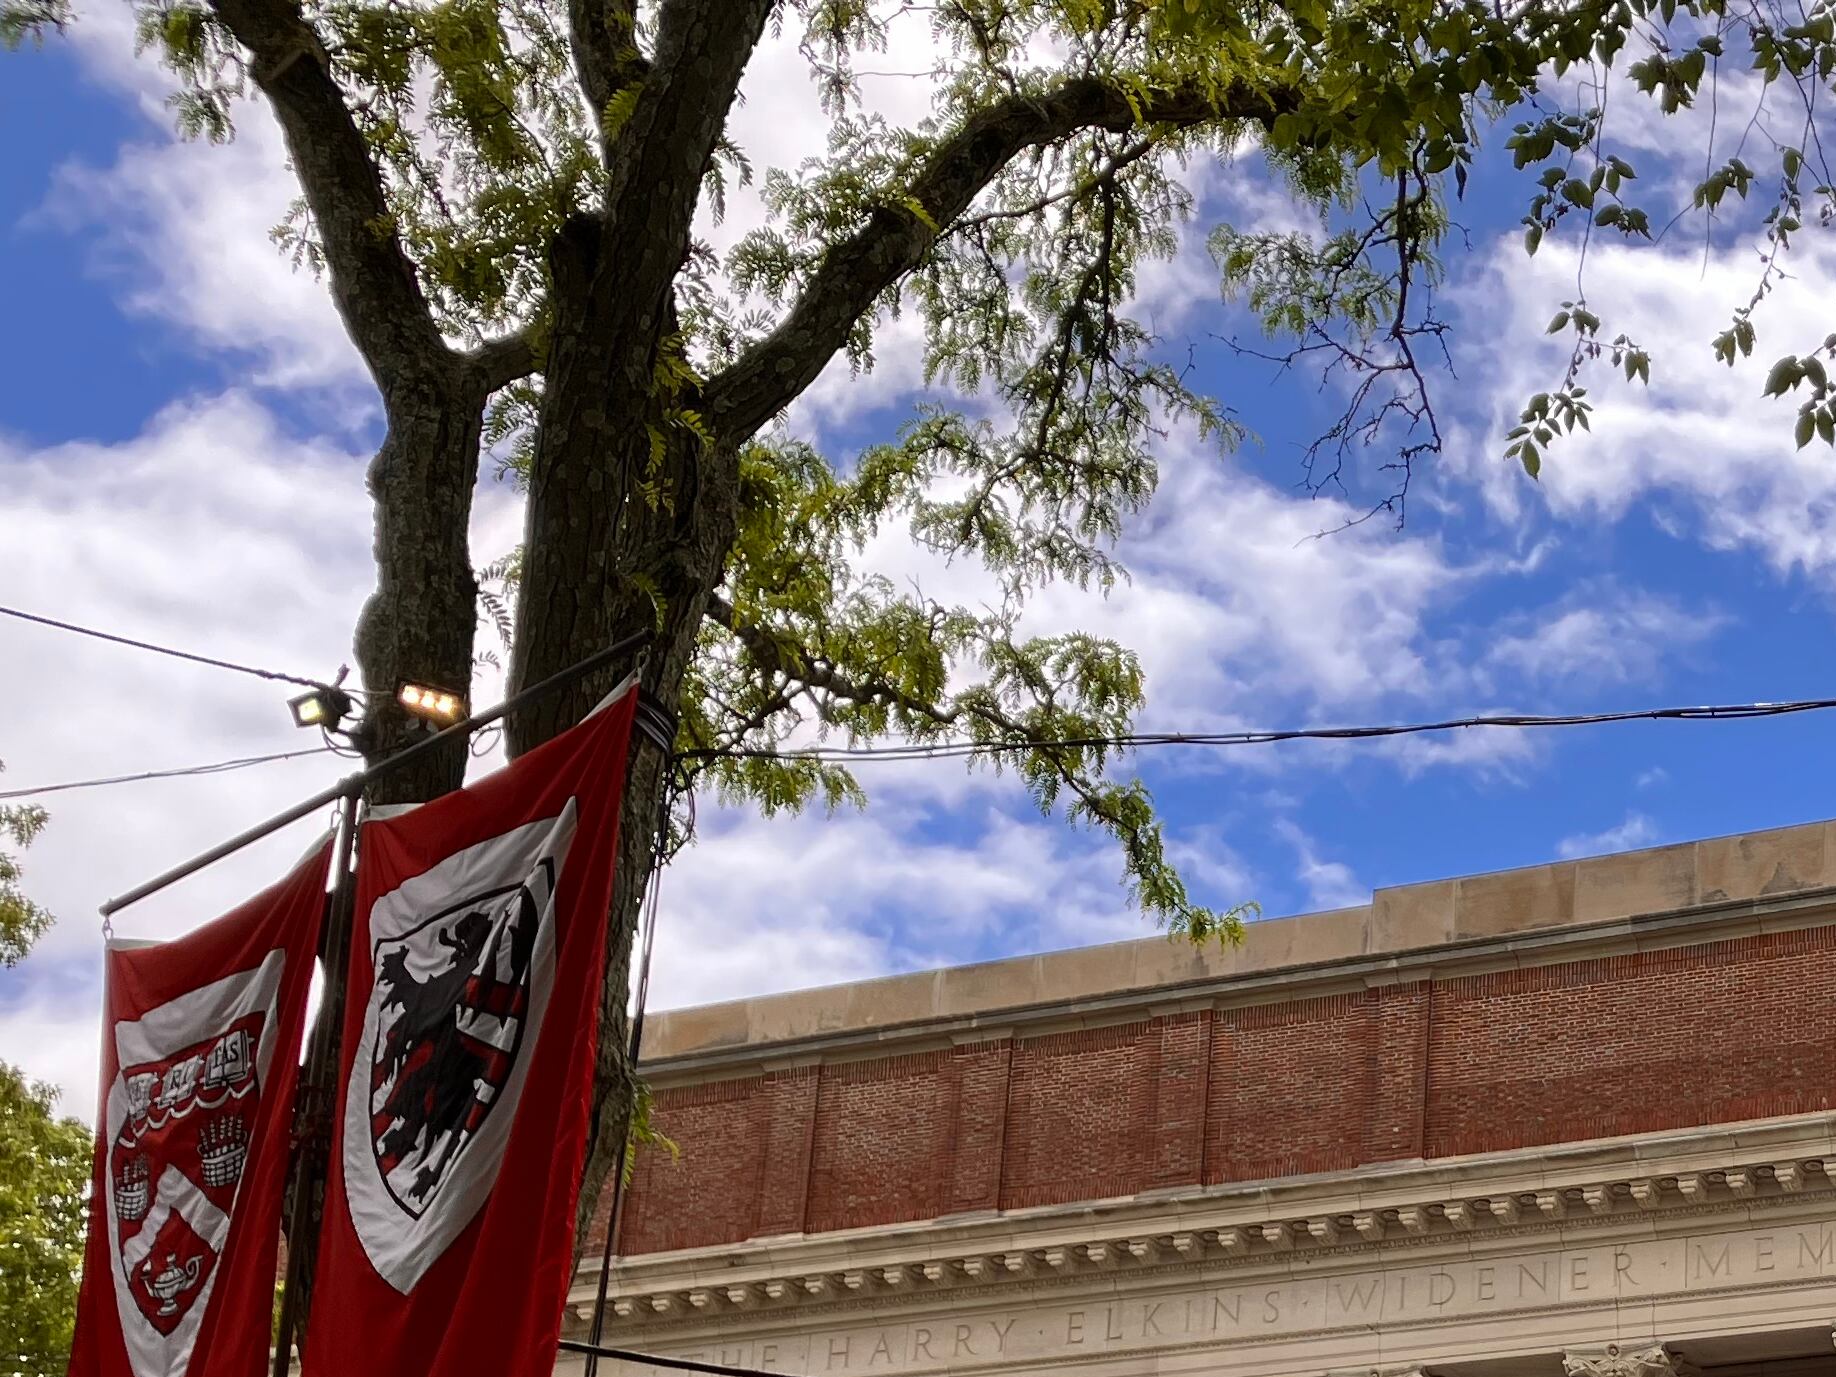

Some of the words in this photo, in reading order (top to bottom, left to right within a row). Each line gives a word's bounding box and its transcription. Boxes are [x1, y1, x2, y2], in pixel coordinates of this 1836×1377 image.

[825, 1317, 1018, 1369] HARRY
[1066, 1288, 1282, 1346] ELKINS
[1333, 1250, 1640, 1313] WIDENER
